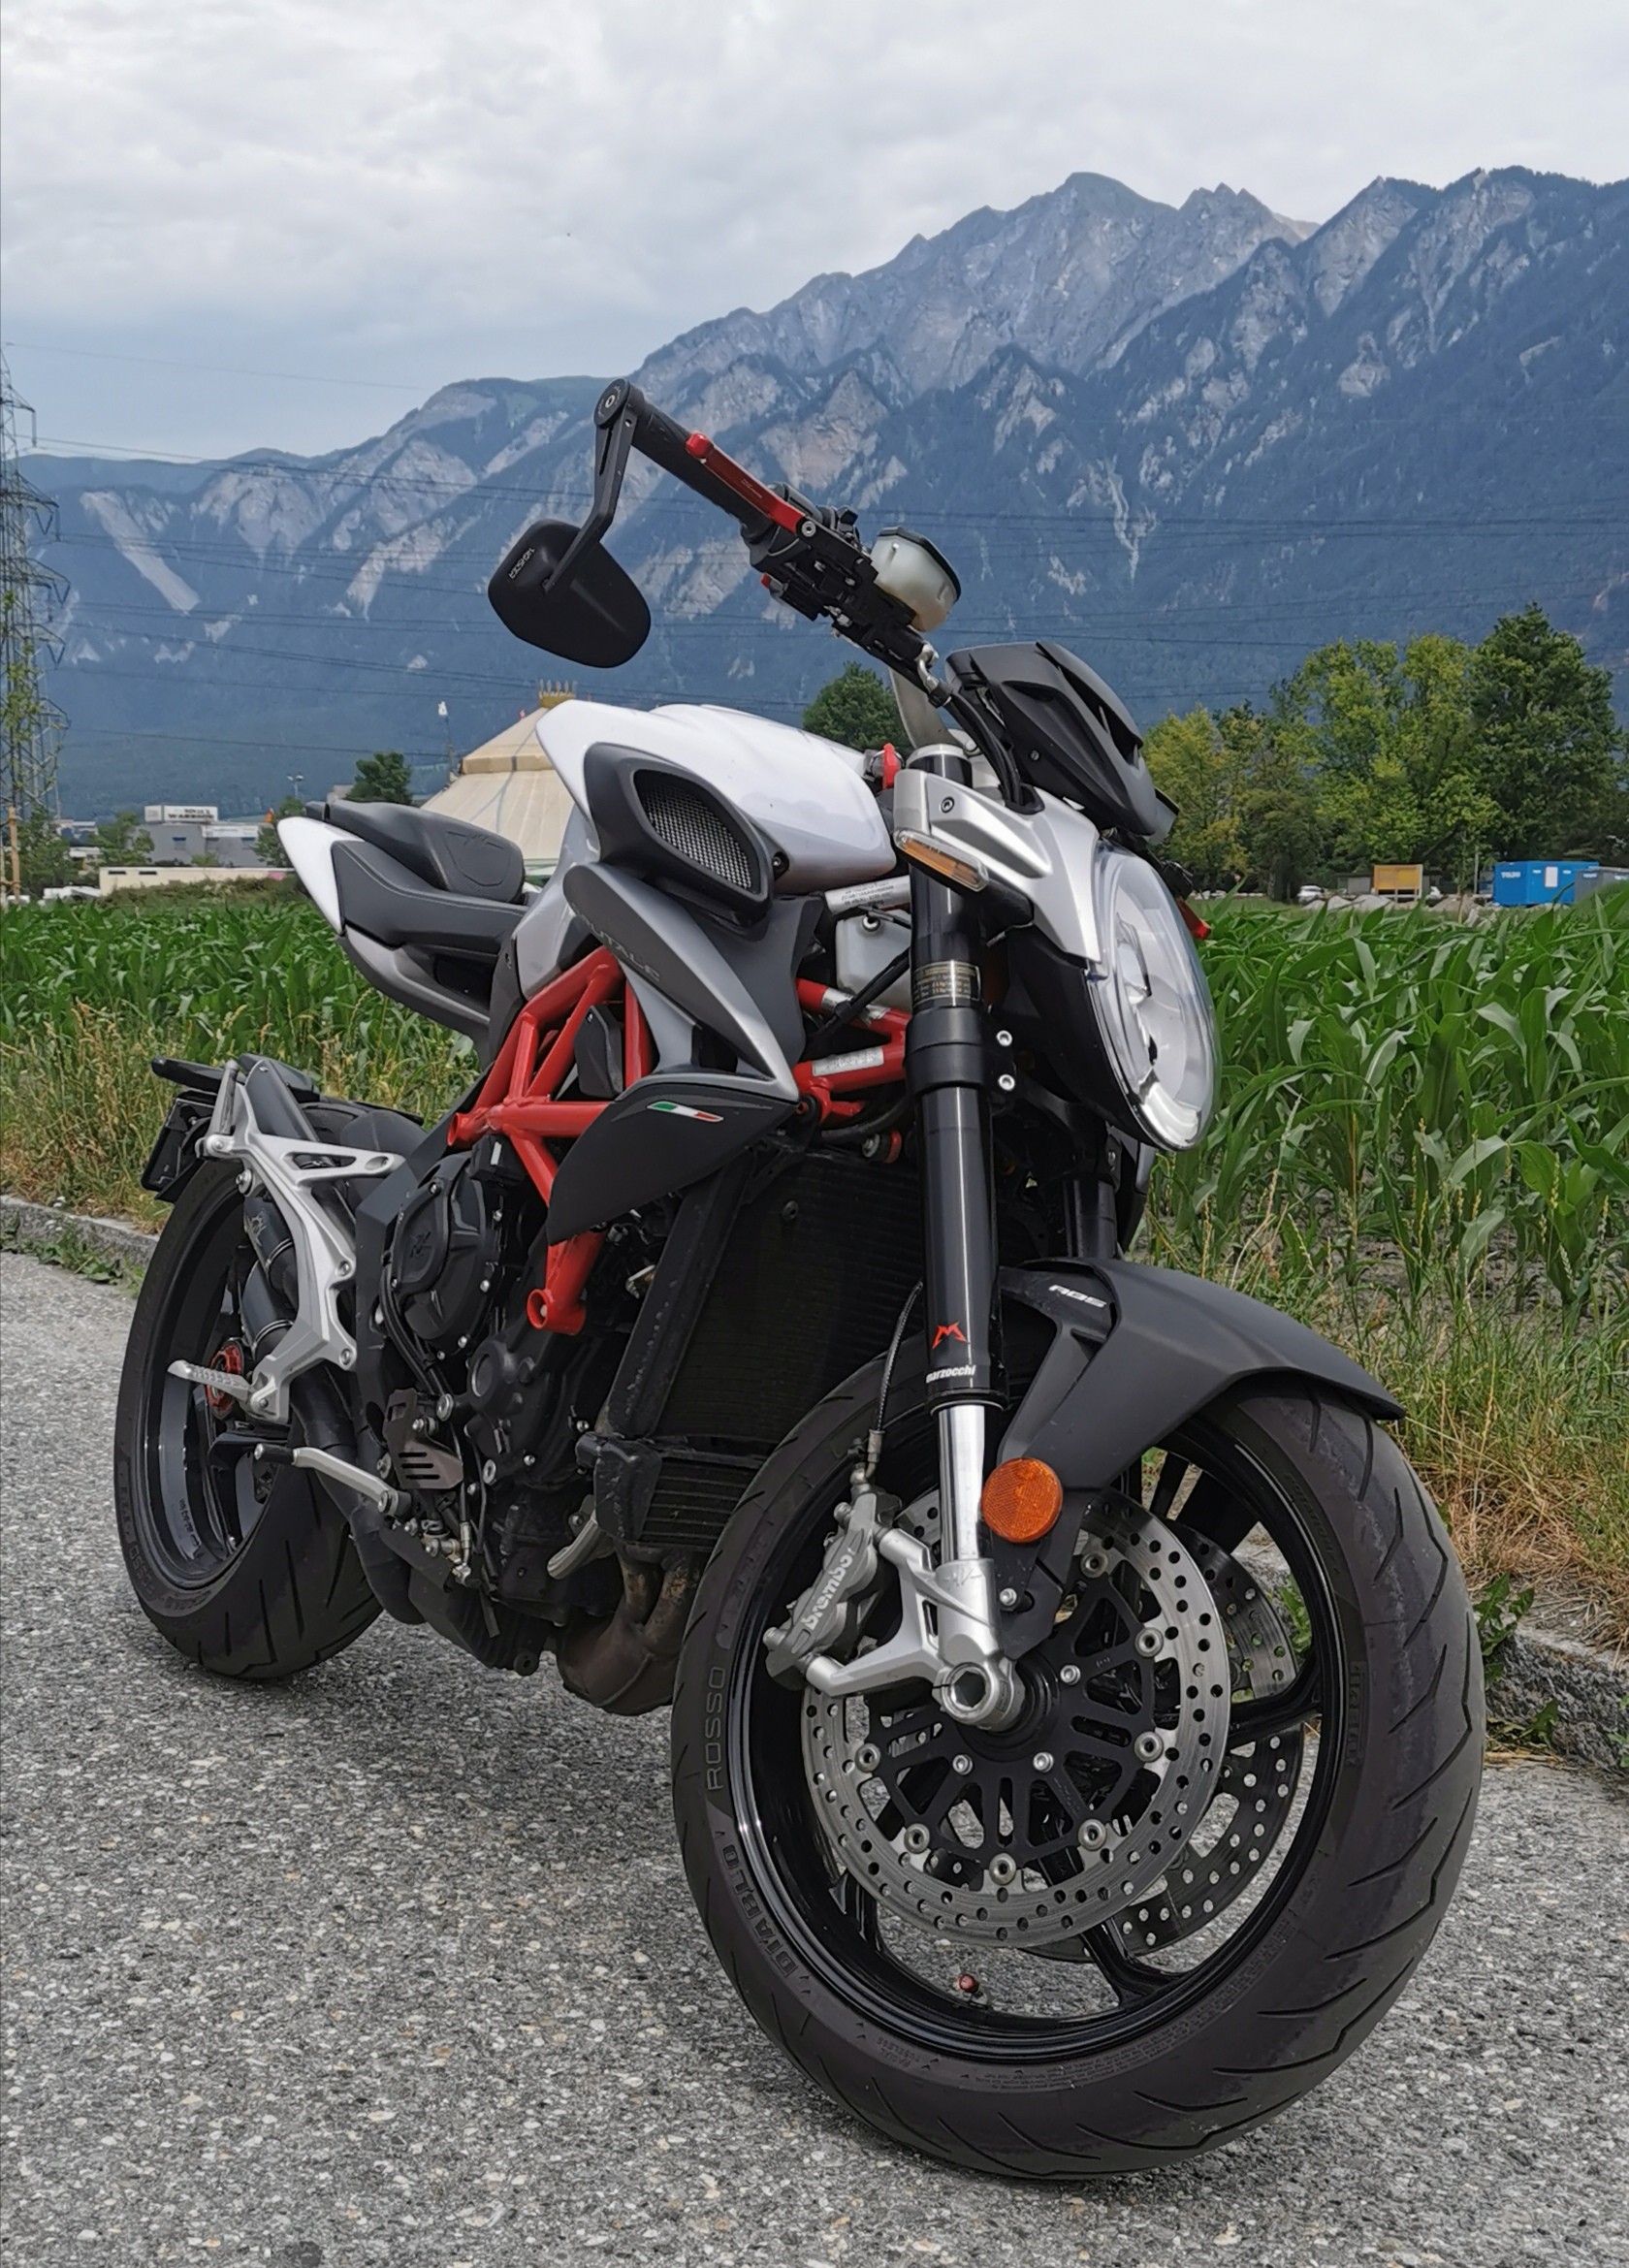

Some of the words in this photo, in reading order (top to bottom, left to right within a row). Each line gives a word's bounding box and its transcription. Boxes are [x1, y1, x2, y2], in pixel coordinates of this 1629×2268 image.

[925, 1363, 976, 1384] marzocchi
[800, 1554, 853, 1631] brembo
[704, 1666, 726, 1790] ROSSO
[721, 1844, 799, 1978] DIABLO
